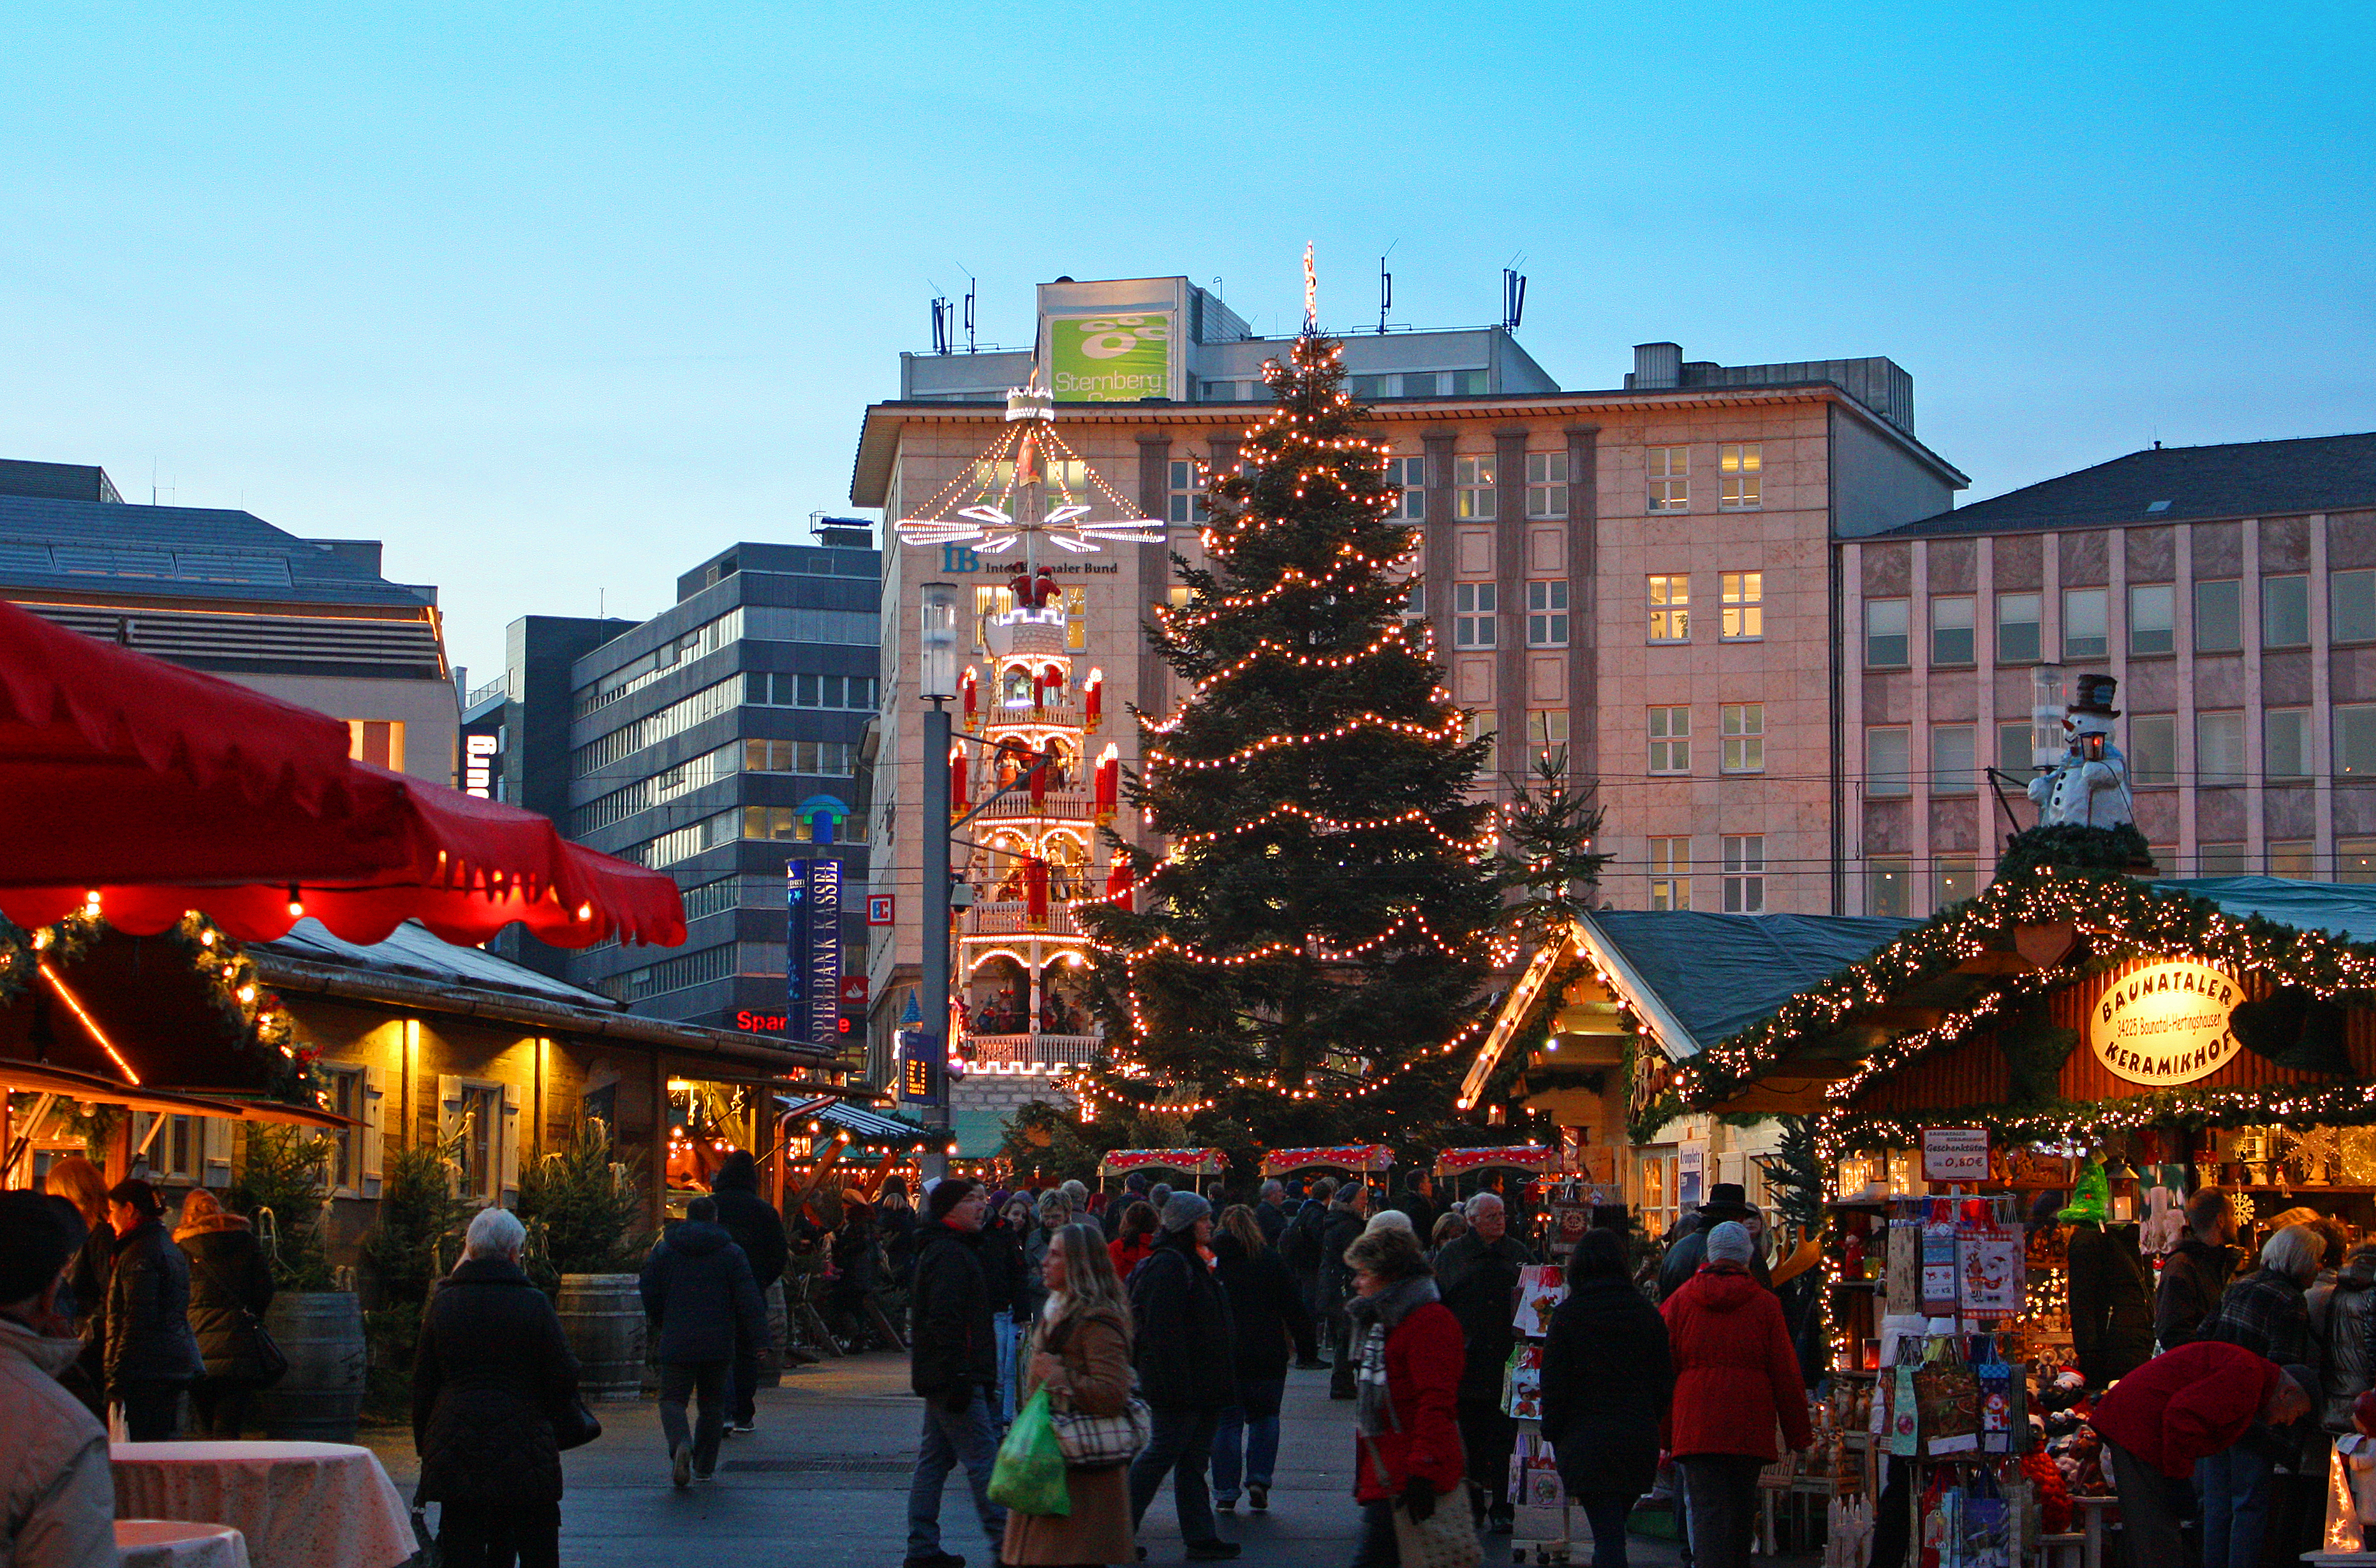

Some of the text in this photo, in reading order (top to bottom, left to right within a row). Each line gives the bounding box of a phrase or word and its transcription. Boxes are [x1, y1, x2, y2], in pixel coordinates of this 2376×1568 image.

[1056, 370, 1162, 393] Sternberg
[1084, 563, 1118, 573] Bund
[812, 861, 839, 1043] SPIELBANK KASSEL
[2102, 972, 2234, 1024] BAUNATALER
[2118, 1009, 2222, 1038] 34225 Baunatal-Hertingshausen
[2105, 1030, 2233, 1076] KERAMIKHOF
